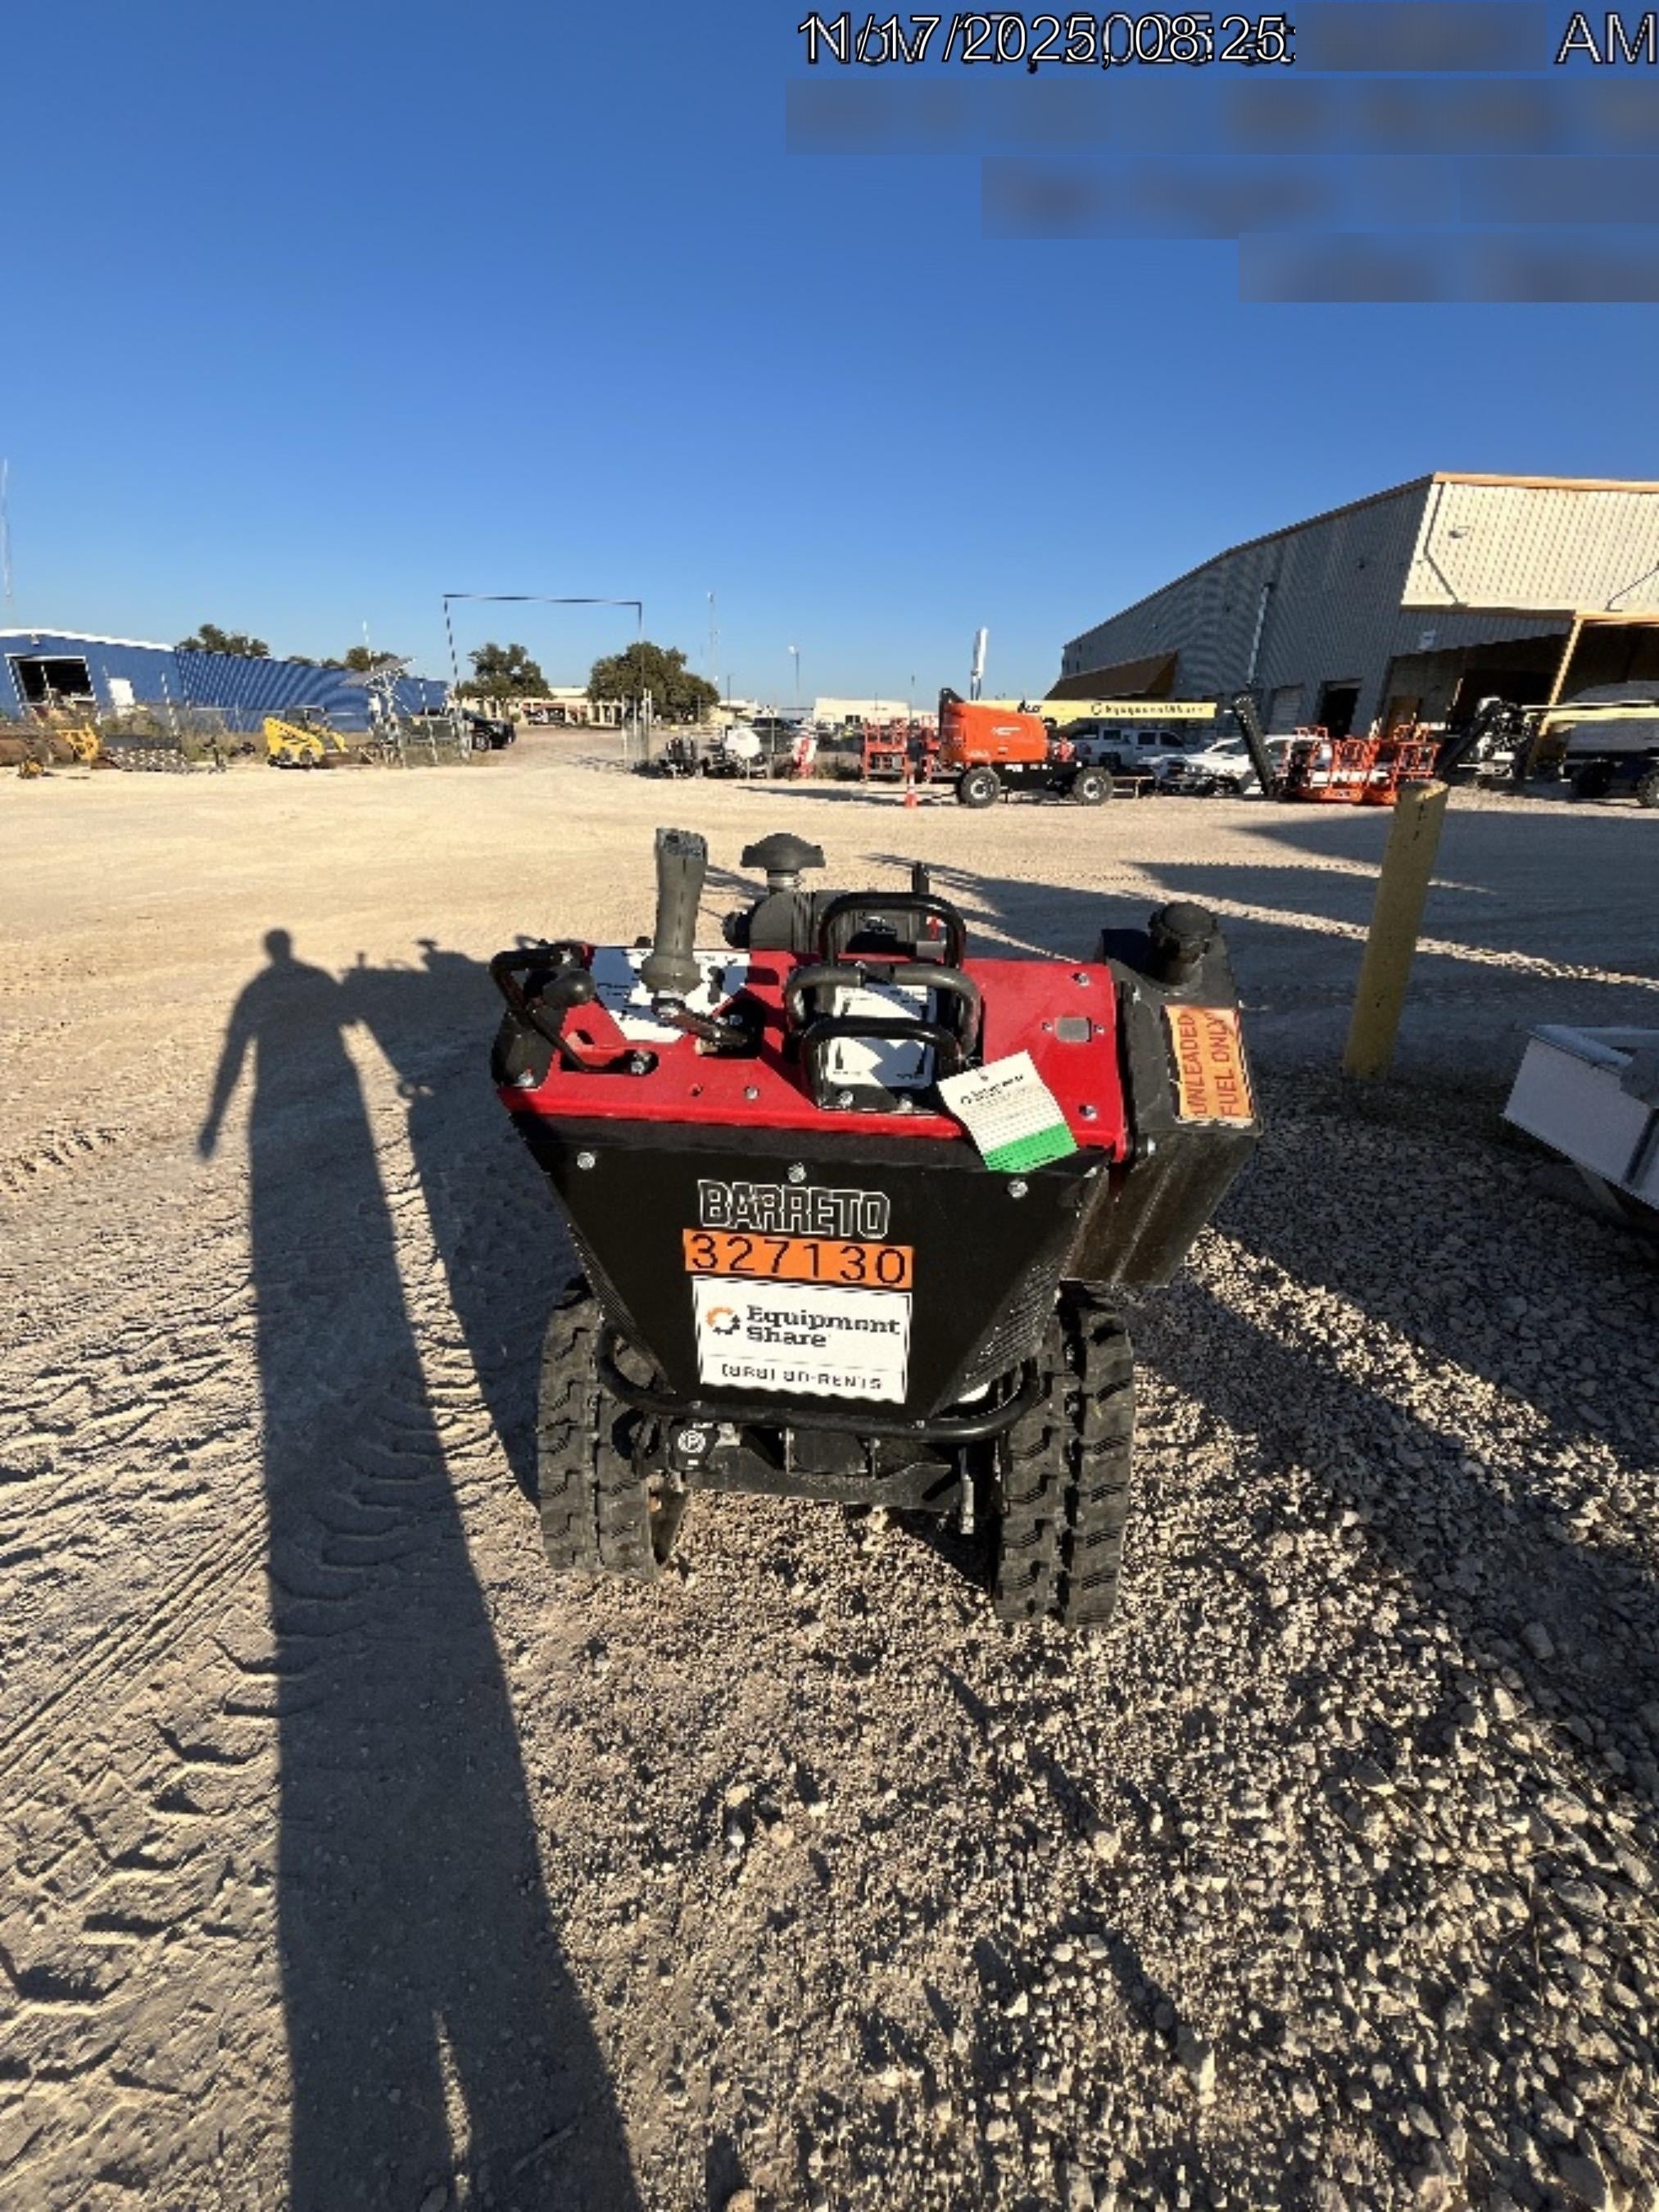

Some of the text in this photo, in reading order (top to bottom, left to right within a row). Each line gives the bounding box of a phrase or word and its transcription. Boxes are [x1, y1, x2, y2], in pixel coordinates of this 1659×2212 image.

[1176, 1013, 1208, 1117] UNLEADED
[1203, 1011, 1243, 1117] FUEL ONLY
[696, 1179, 891, 1239] BARRETO
[691, 1233, 905, 1284] 327130
[746, 1304, 900, 1335] Equipment
[746, 1326, 827, 1348] Share
